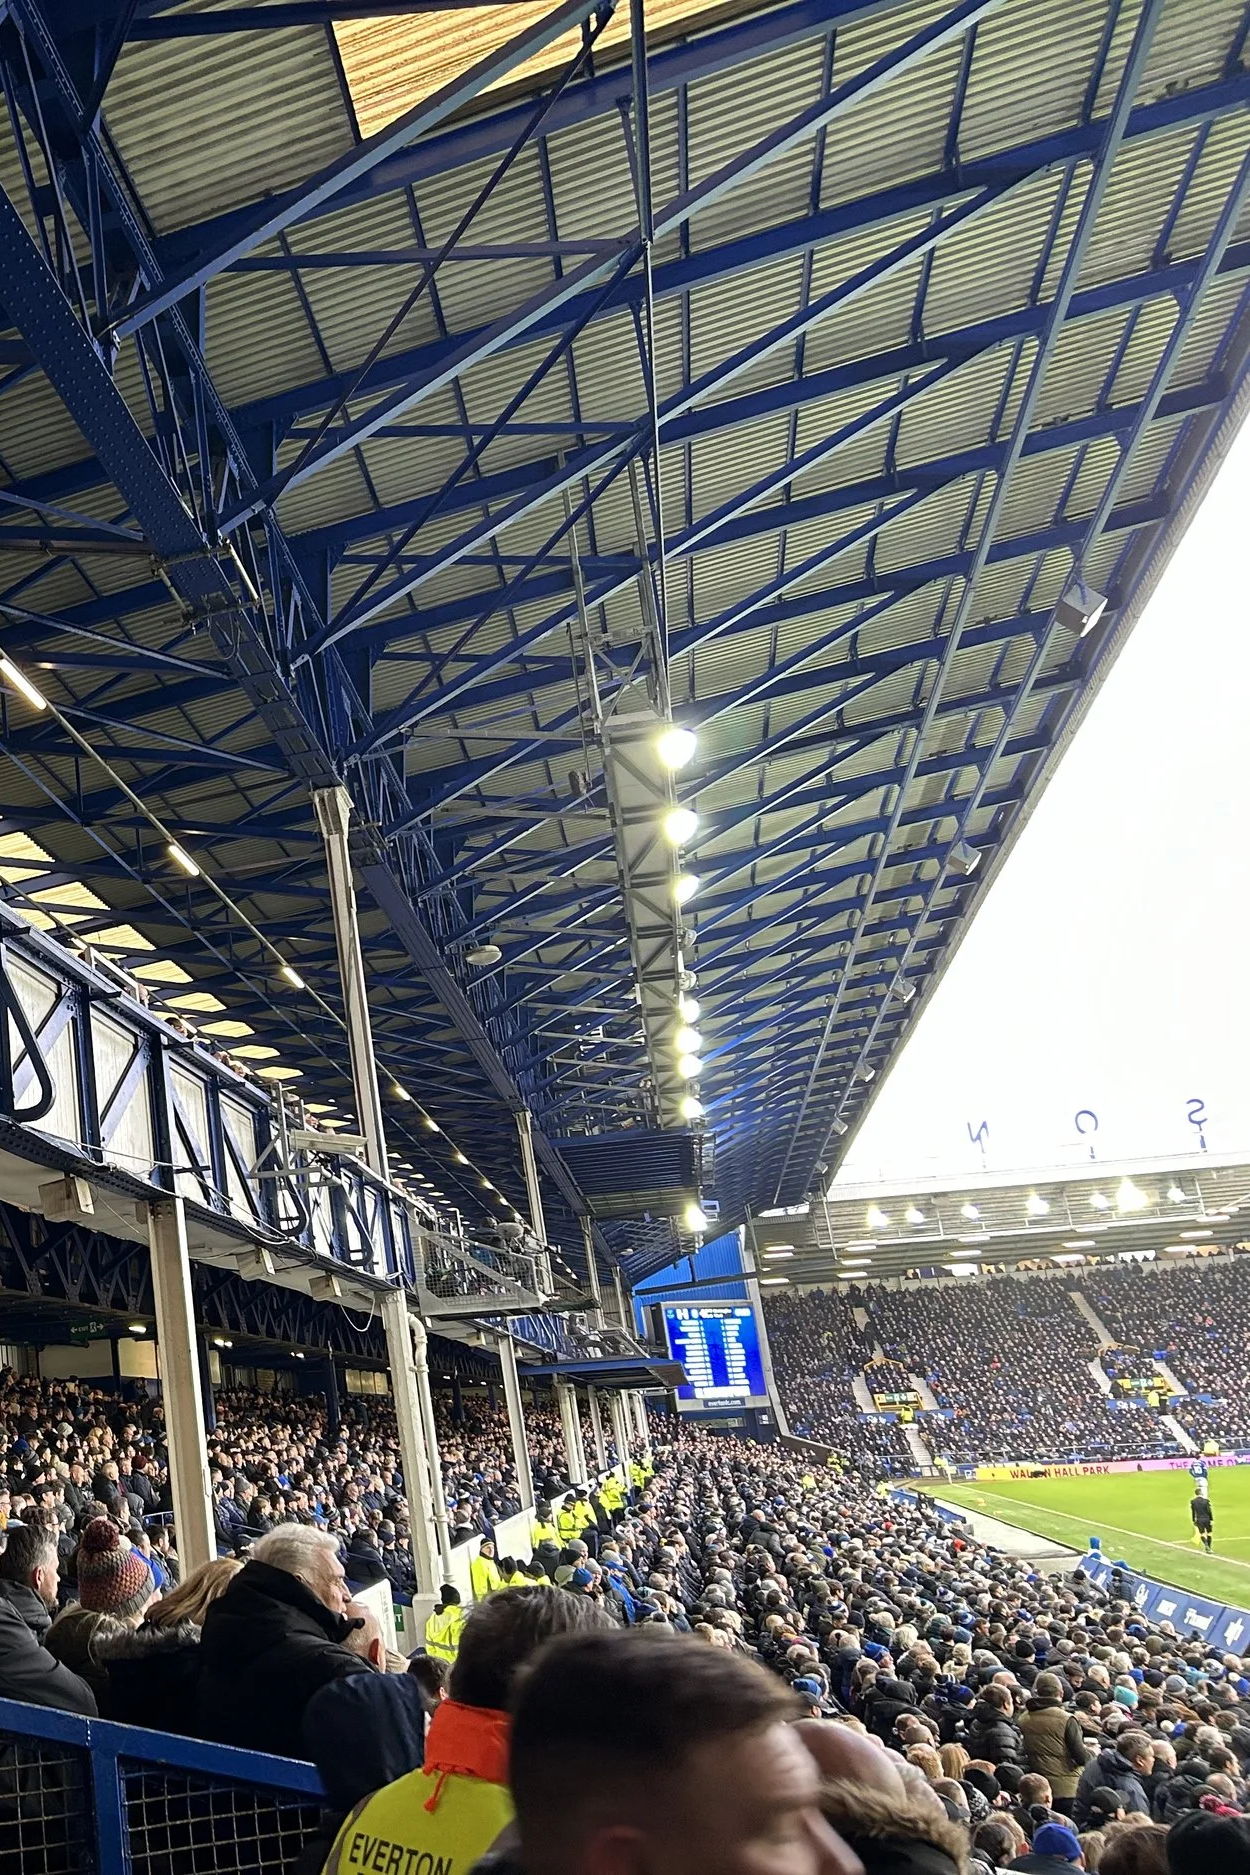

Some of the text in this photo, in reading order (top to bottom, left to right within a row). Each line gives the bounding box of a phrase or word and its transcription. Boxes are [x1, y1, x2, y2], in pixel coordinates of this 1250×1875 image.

[1054, 1467, 1080, 1477] HALL
[1082, 1465, 1110, 1476] PARK
[1169, 1461, 1188, 1470] THE
[349, 1832, 453, 1875] EVERTON
